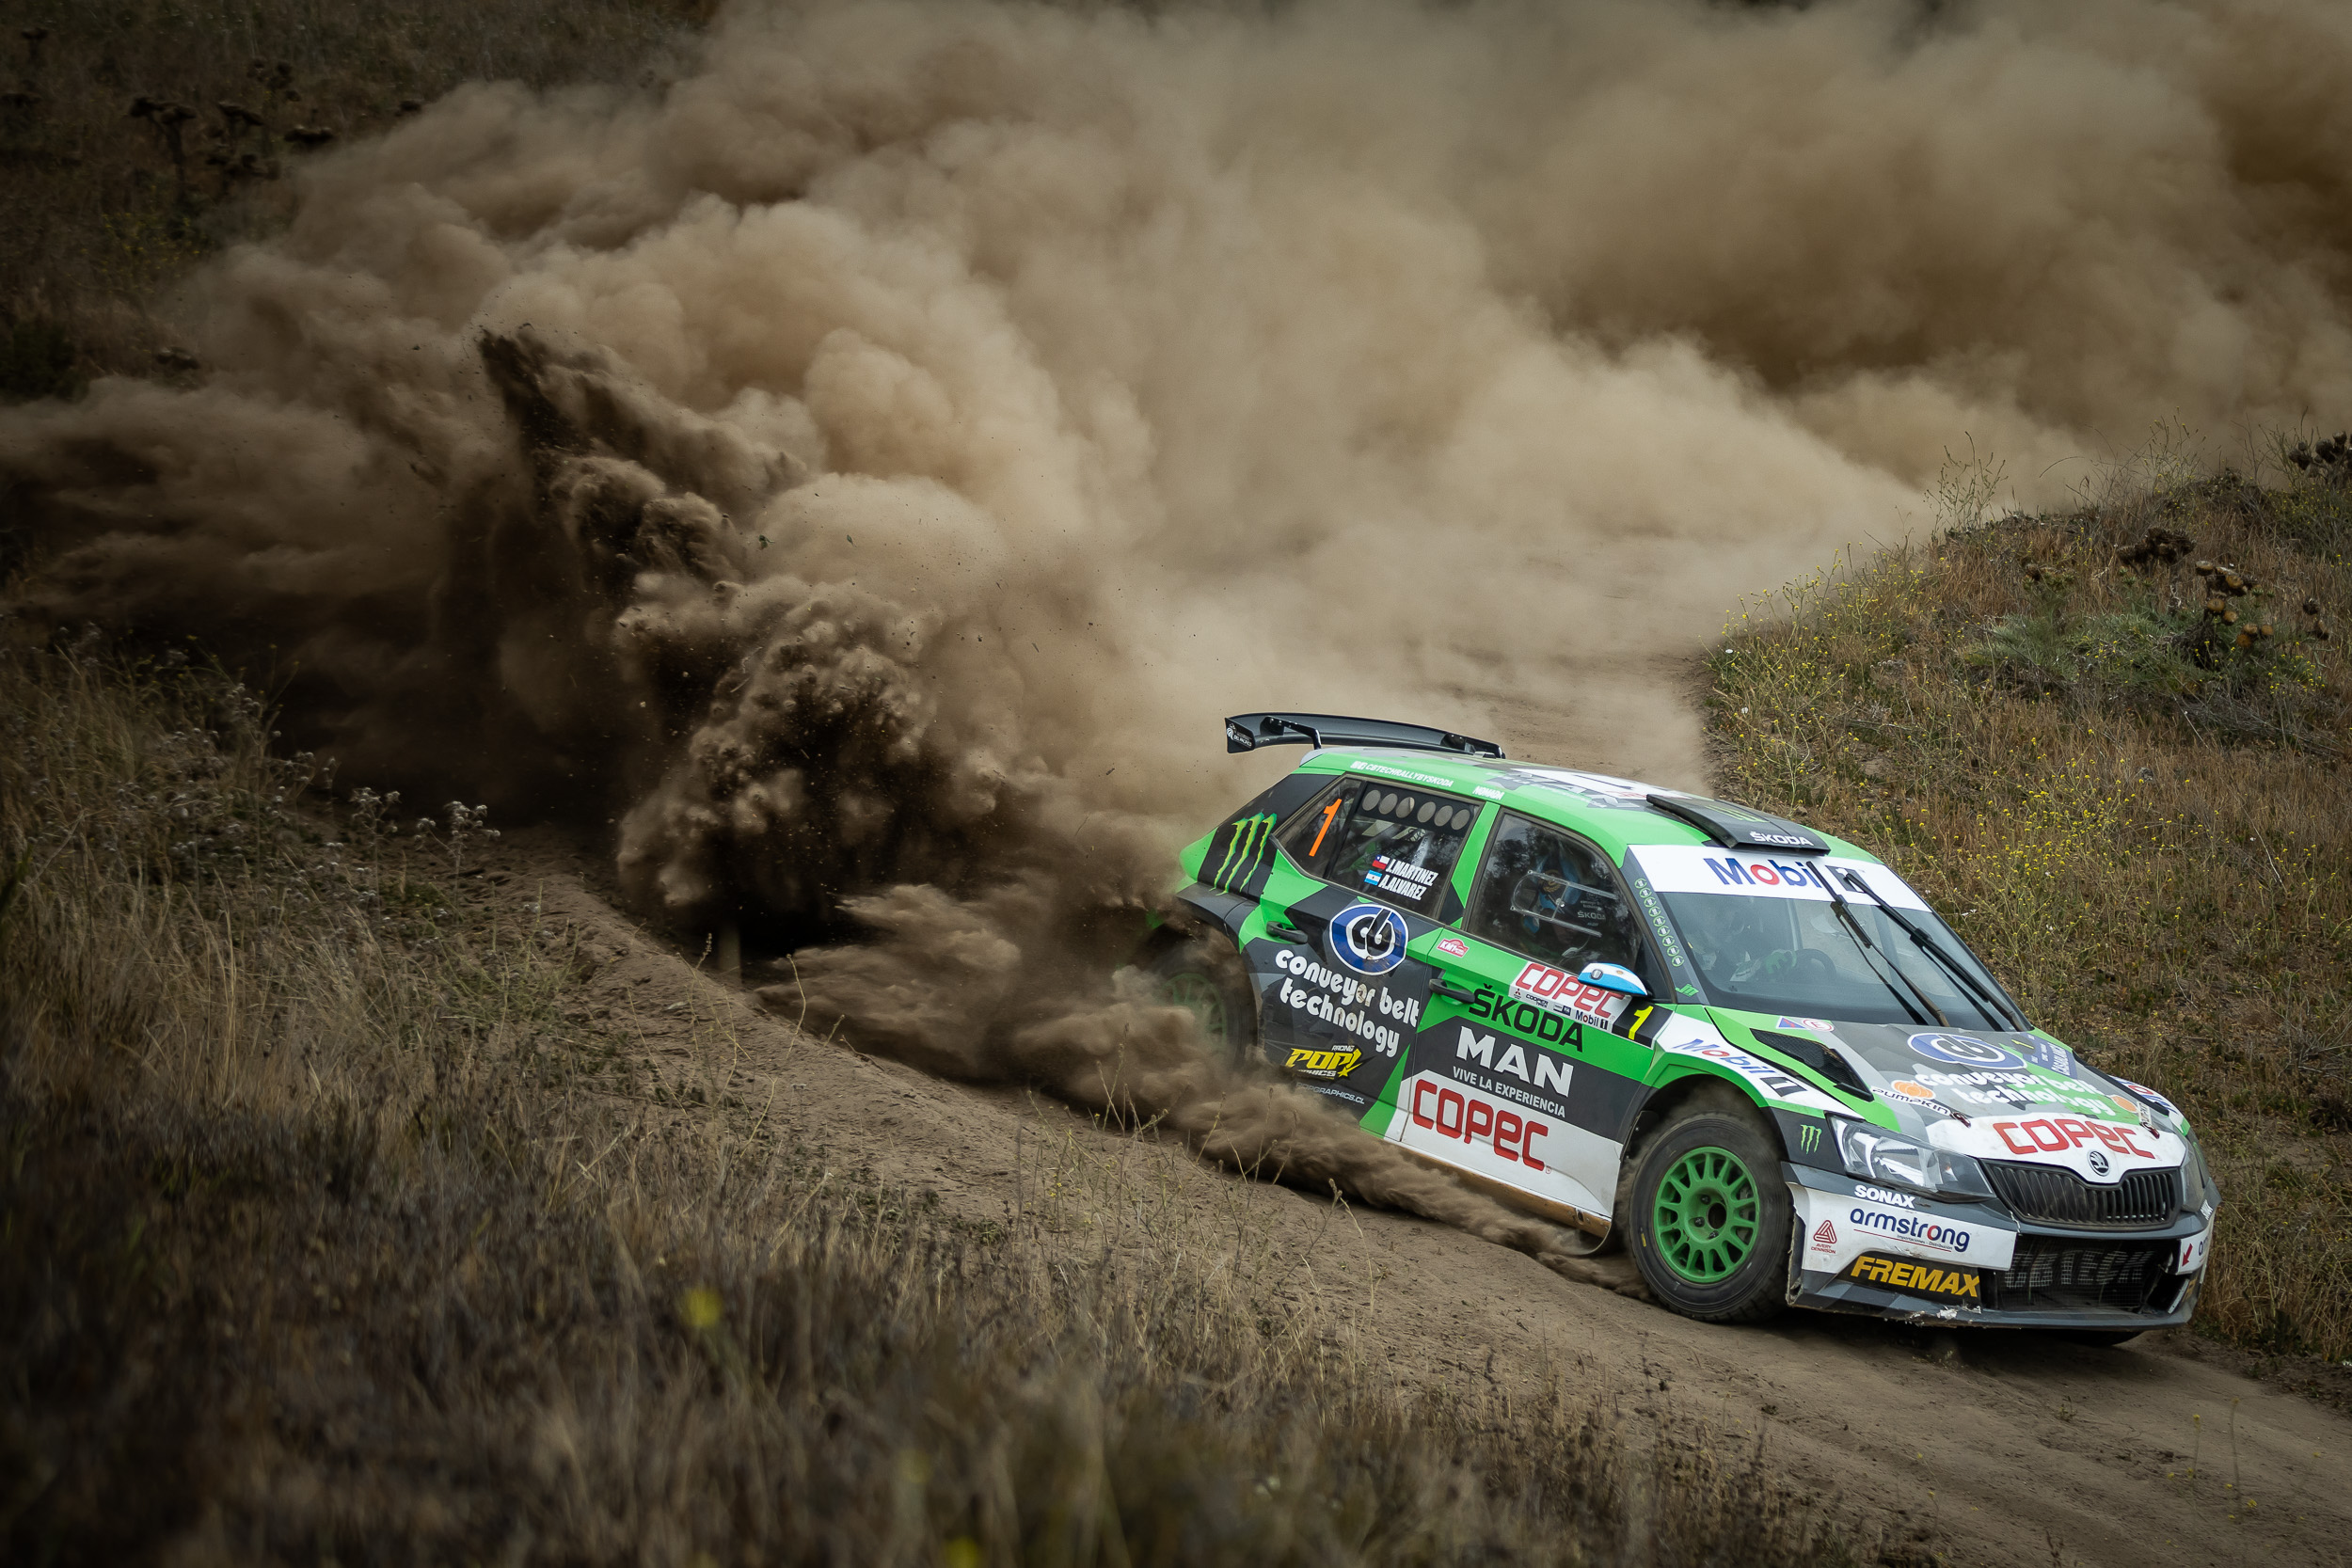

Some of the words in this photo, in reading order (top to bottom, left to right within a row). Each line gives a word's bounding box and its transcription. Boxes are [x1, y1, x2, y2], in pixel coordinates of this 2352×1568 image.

[1366, 764, 1454, 787] CBTECHRALLYBYSKODA
[1309, 798, 1343, 857] 1
[1749, 832, 1815, 847] ŠKODA
[1377, 874, 1427, 901] A.ALVAREZ
[1385, 859, 1439, 887] J.MARTINEZ
[1703, 857, 1823, 889] Mobi
[1275, 949, 1375, 1007] conveyor
[1379, 986, 1420, 1028] belt
[1279, 976, 1400, 1058] technology
[1468, 983, 1583, 1053] ŠKODA
[1575, 1009, 1598, 1027] Mobil
[1600, 1019, 1608, 1030] 1
[1628, 1006, 1654, 1041] 1
[1456, 1025, 1574, 1099] MAN
[1673, 1038, 1778, 1075] Mobil
[1295, 1082, 1365, 1104] POPGRAPHICS.CL
[1453, 1066, 1478, 1086] VIVE
[1479, 1075, 1493, 1091] LA
[1494, 1084, 1566, 1118] EXPERIENCIA
[1915, 1071, 2047, 1090] conveyor
[2038, 1075, 2105, 1096] belt
[1951, 1085, 2116, 1117] technology
[1854, 1184, 1915, 1210] SONAX
[1850, 1208, 1970, 1253] armstrong
[1810, 1246, 1836, 1255] DENNISON
[1851, 1255, 1980, 1298] FREMAX
